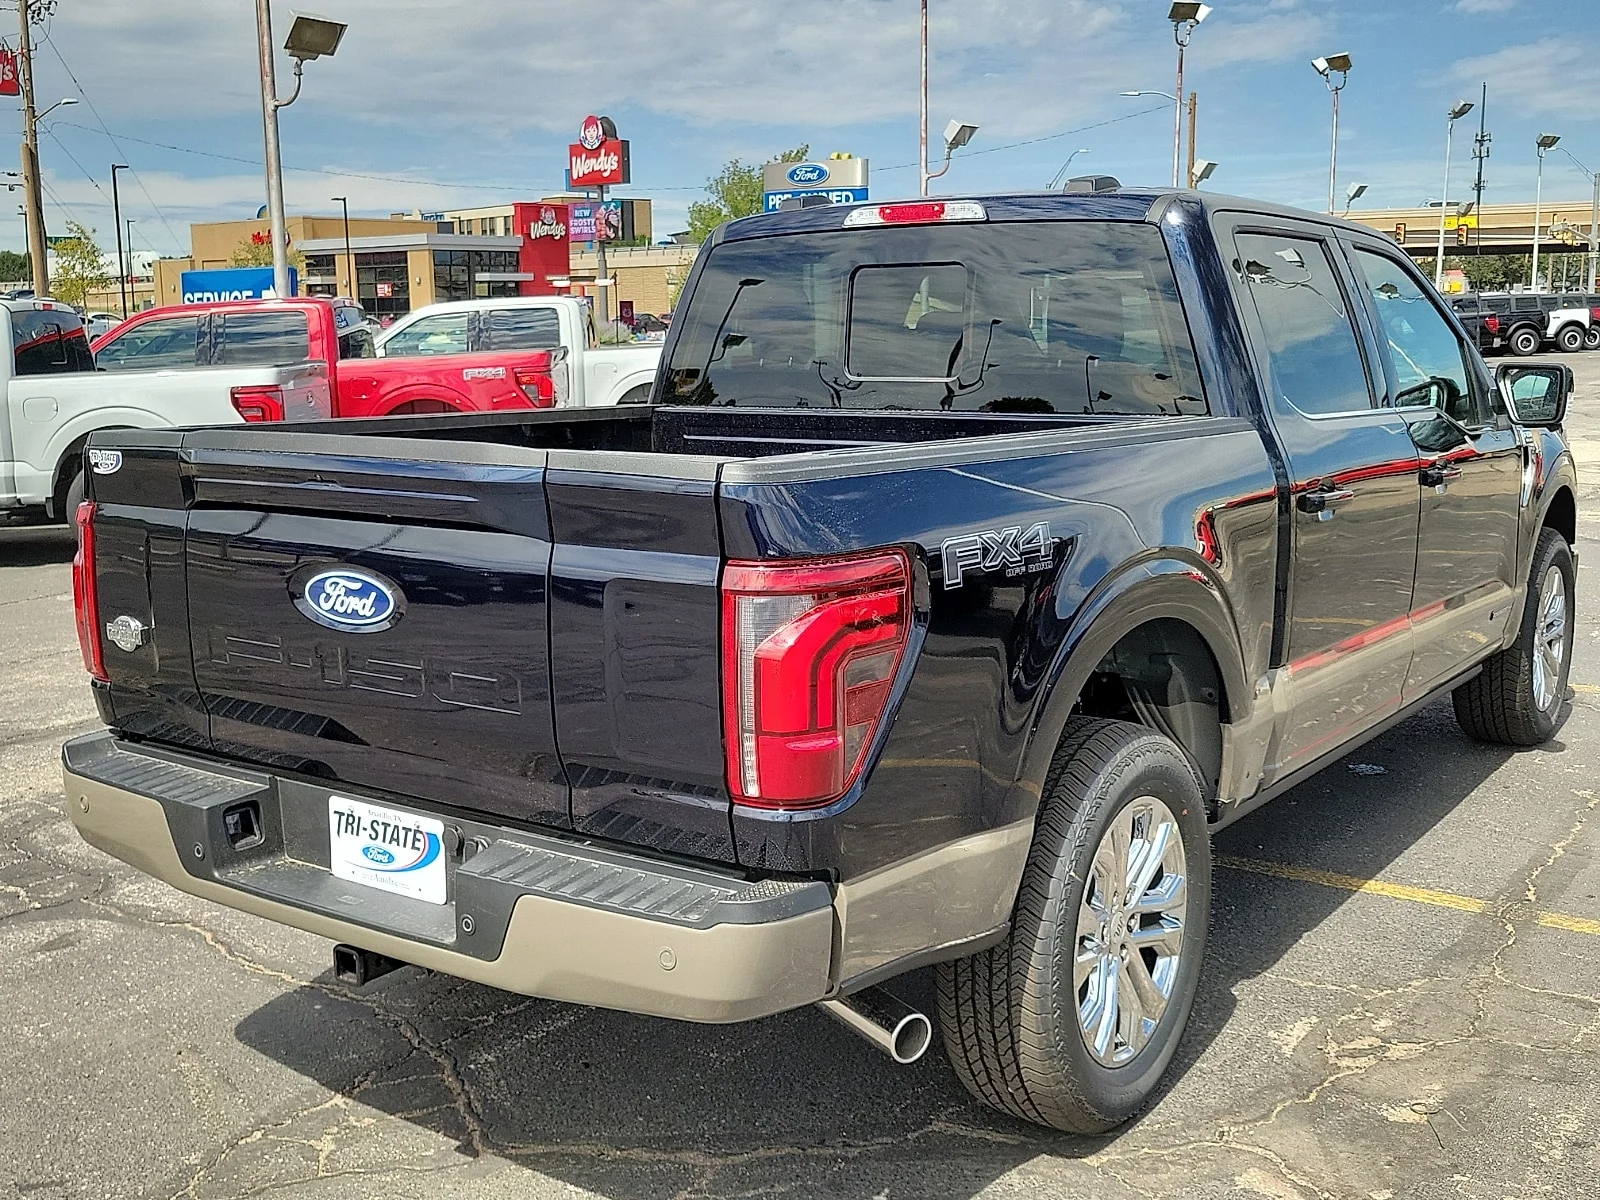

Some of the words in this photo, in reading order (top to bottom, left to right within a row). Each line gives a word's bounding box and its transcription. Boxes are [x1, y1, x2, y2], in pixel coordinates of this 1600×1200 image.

[571, 148, 619, 180] Wendy's
[794, 167, 820, 181] Ford
[574, 209, 591, 217] NEW
[530, 220, 567, 240] Wendy's
[570, 218, 596, 227] FROSTY
[570, 226, 597, 235] SWIRLS
[941, 521, 1053, 590] FX4
[1006, 567, 1026, 578] OFF
[1028, 560, 1053, 573] ROAD
[318, 575, 377, 619] Ford
[333, 810, 424, 851] TRI-STATE
[367, 846, 390, 863] Ford
